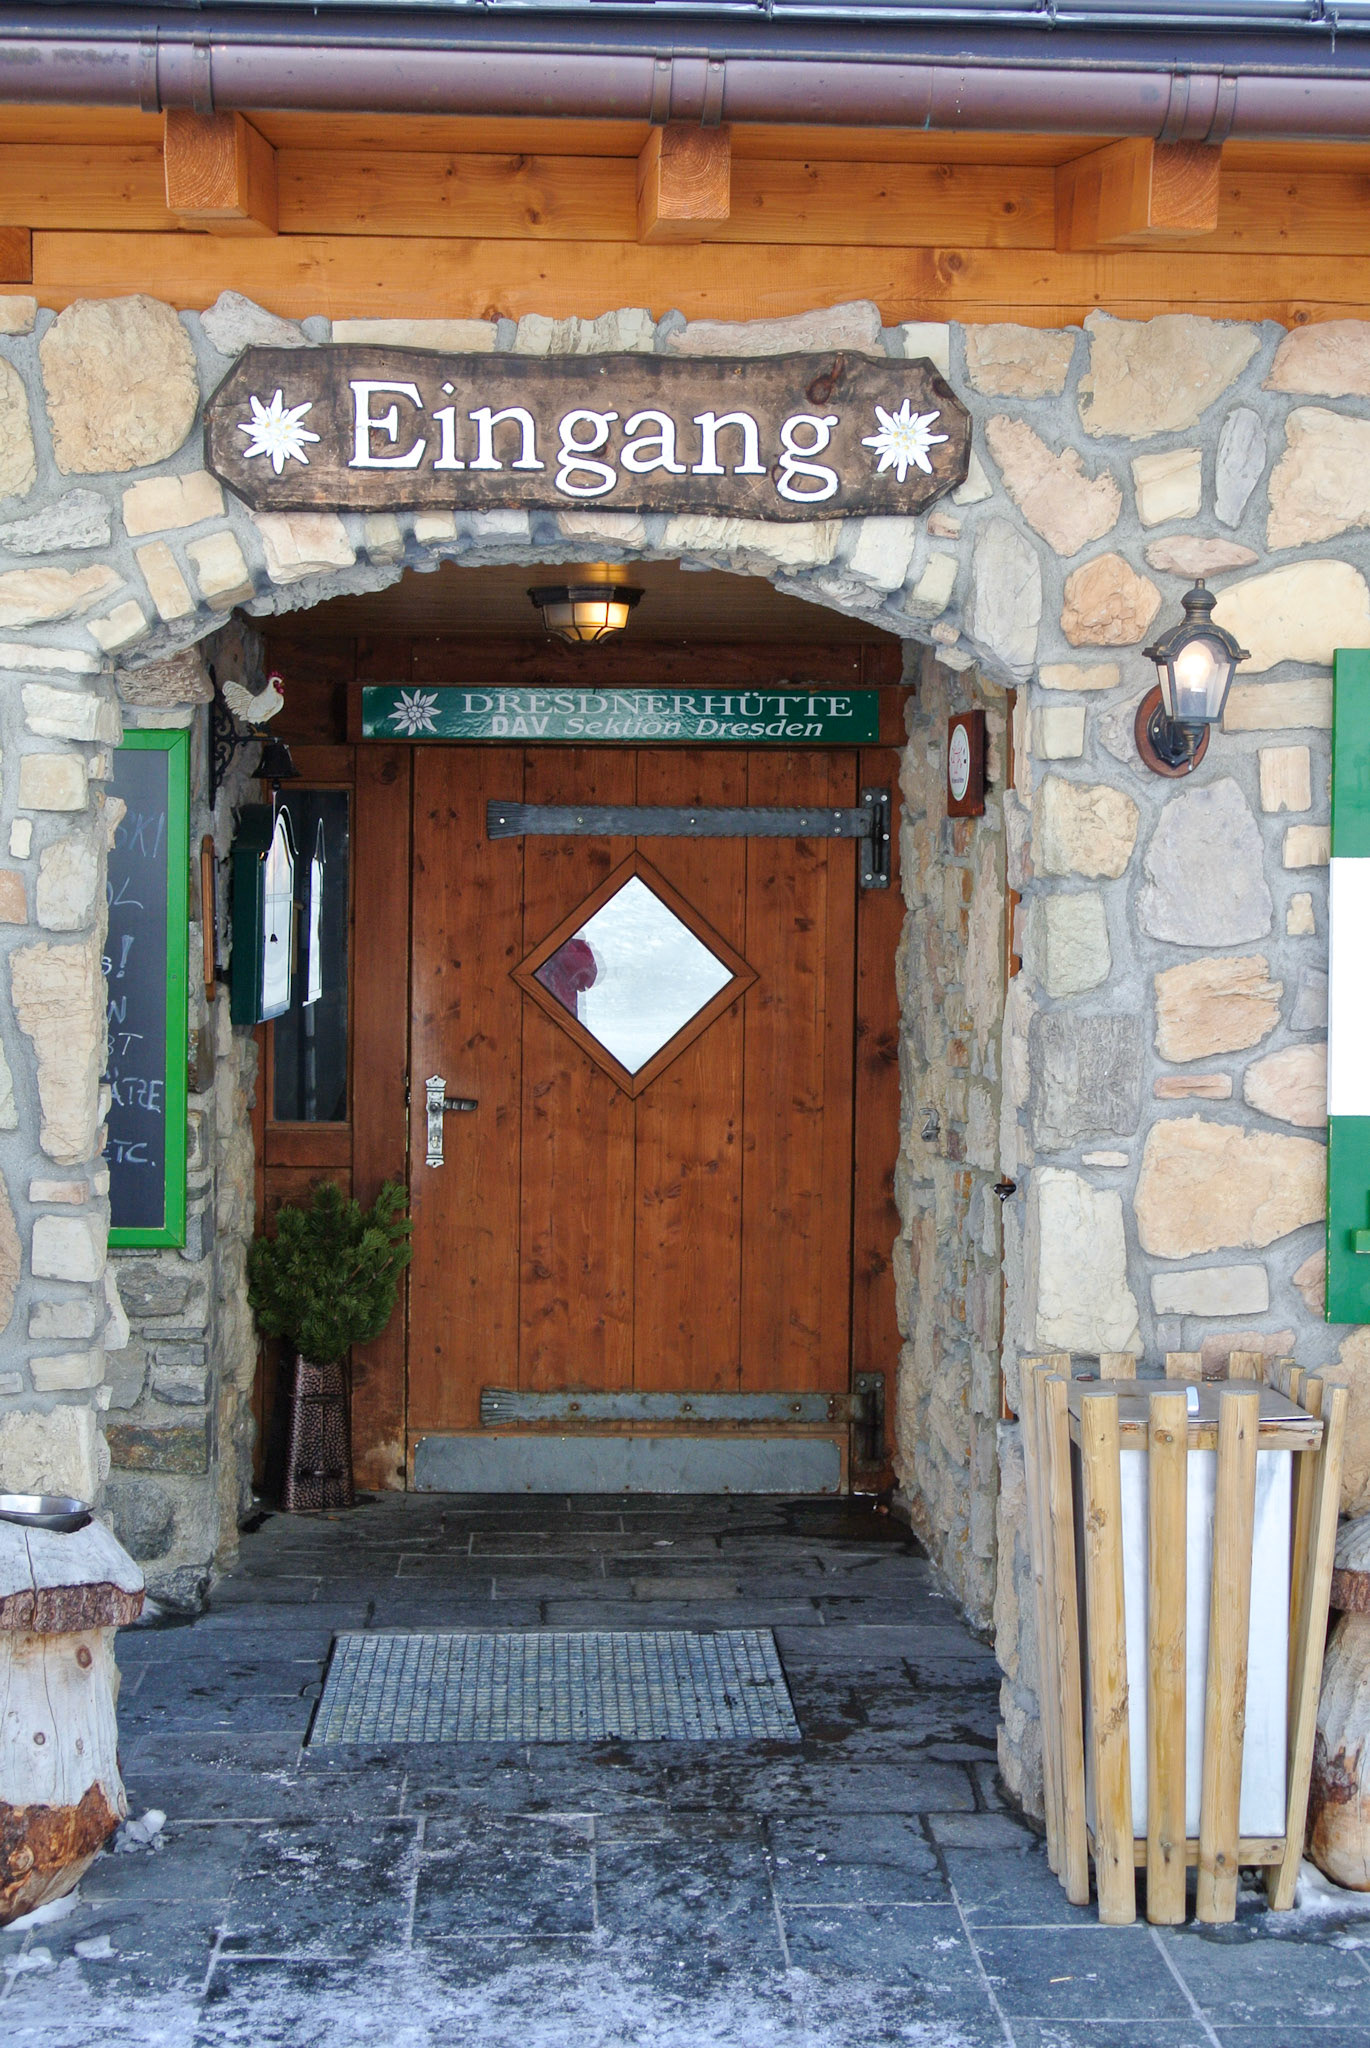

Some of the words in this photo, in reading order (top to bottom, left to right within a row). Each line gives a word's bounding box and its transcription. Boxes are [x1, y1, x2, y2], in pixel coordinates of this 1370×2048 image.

[347, 380, 840, 502] Eingang
[461, 692, 853, 717] DRESDNERHÜTTE
[491, 716, 549, 736] DAV
[564, 717, 682, 736] Sektion
[694, 718, 823, 738] Dresden
